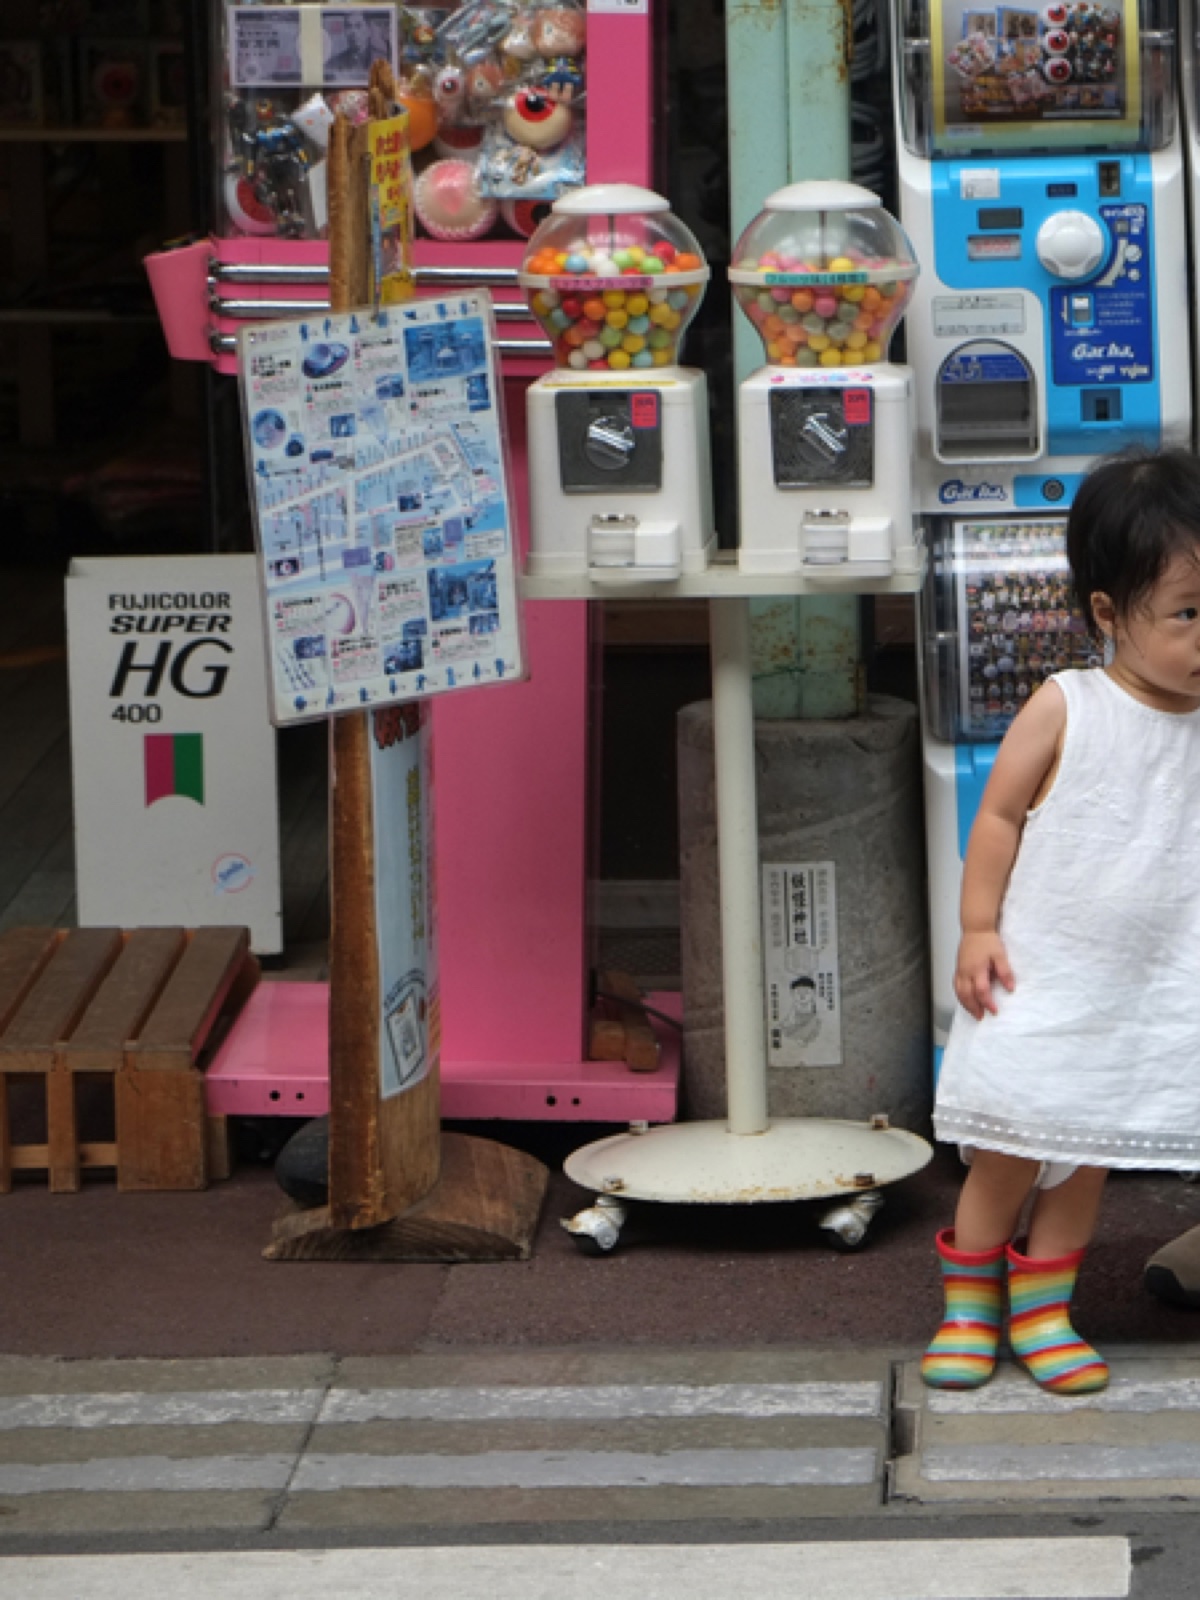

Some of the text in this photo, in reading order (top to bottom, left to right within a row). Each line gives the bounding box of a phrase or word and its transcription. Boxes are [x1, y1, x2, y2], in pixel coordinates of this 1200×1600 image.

[108, 592, 231, 611] FUJICOLOR
[109, 613, 232, 634] SUPER
[109, 637, 234, 699] HG
[111, 703, 162, 723] 400
